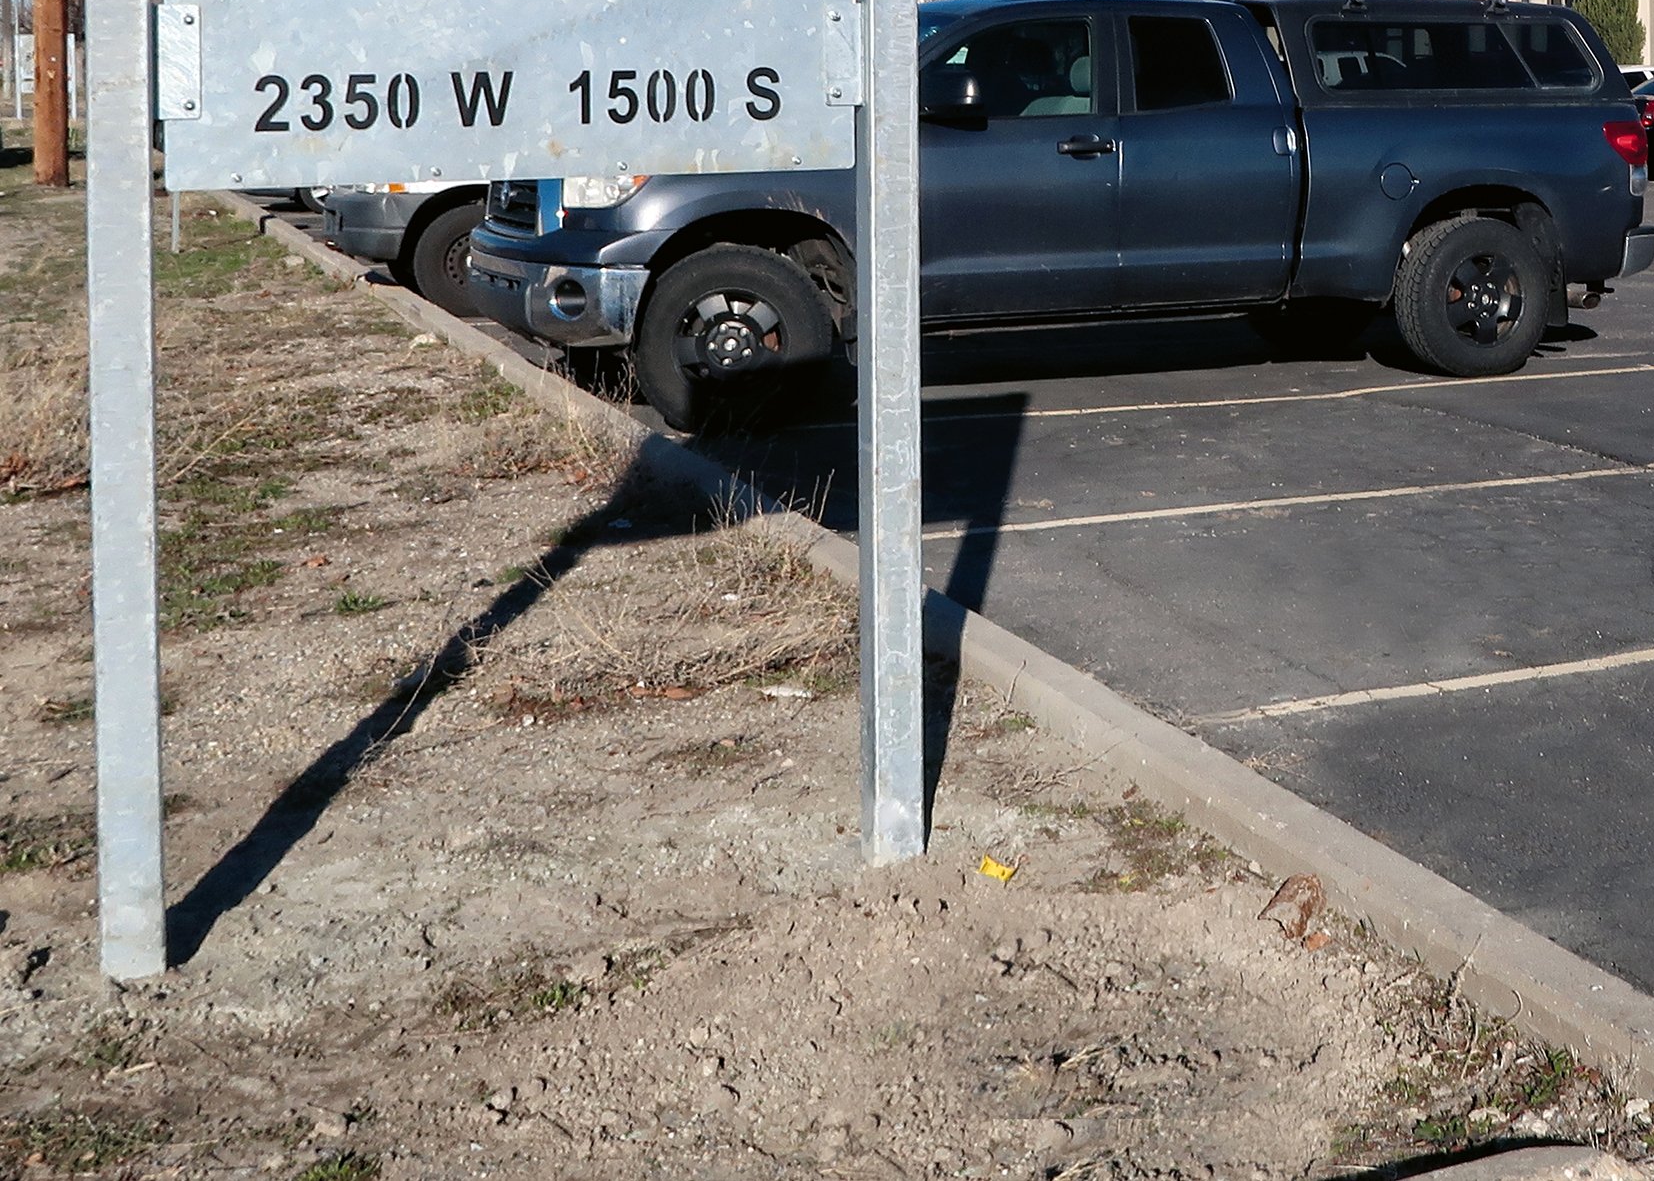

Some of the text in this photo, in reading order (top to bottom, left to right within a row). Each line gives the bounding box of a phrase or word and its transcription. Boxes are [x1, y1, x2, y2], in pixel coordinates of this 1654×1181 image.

[254, 67, 782, 133] 2350 W 1500 S
